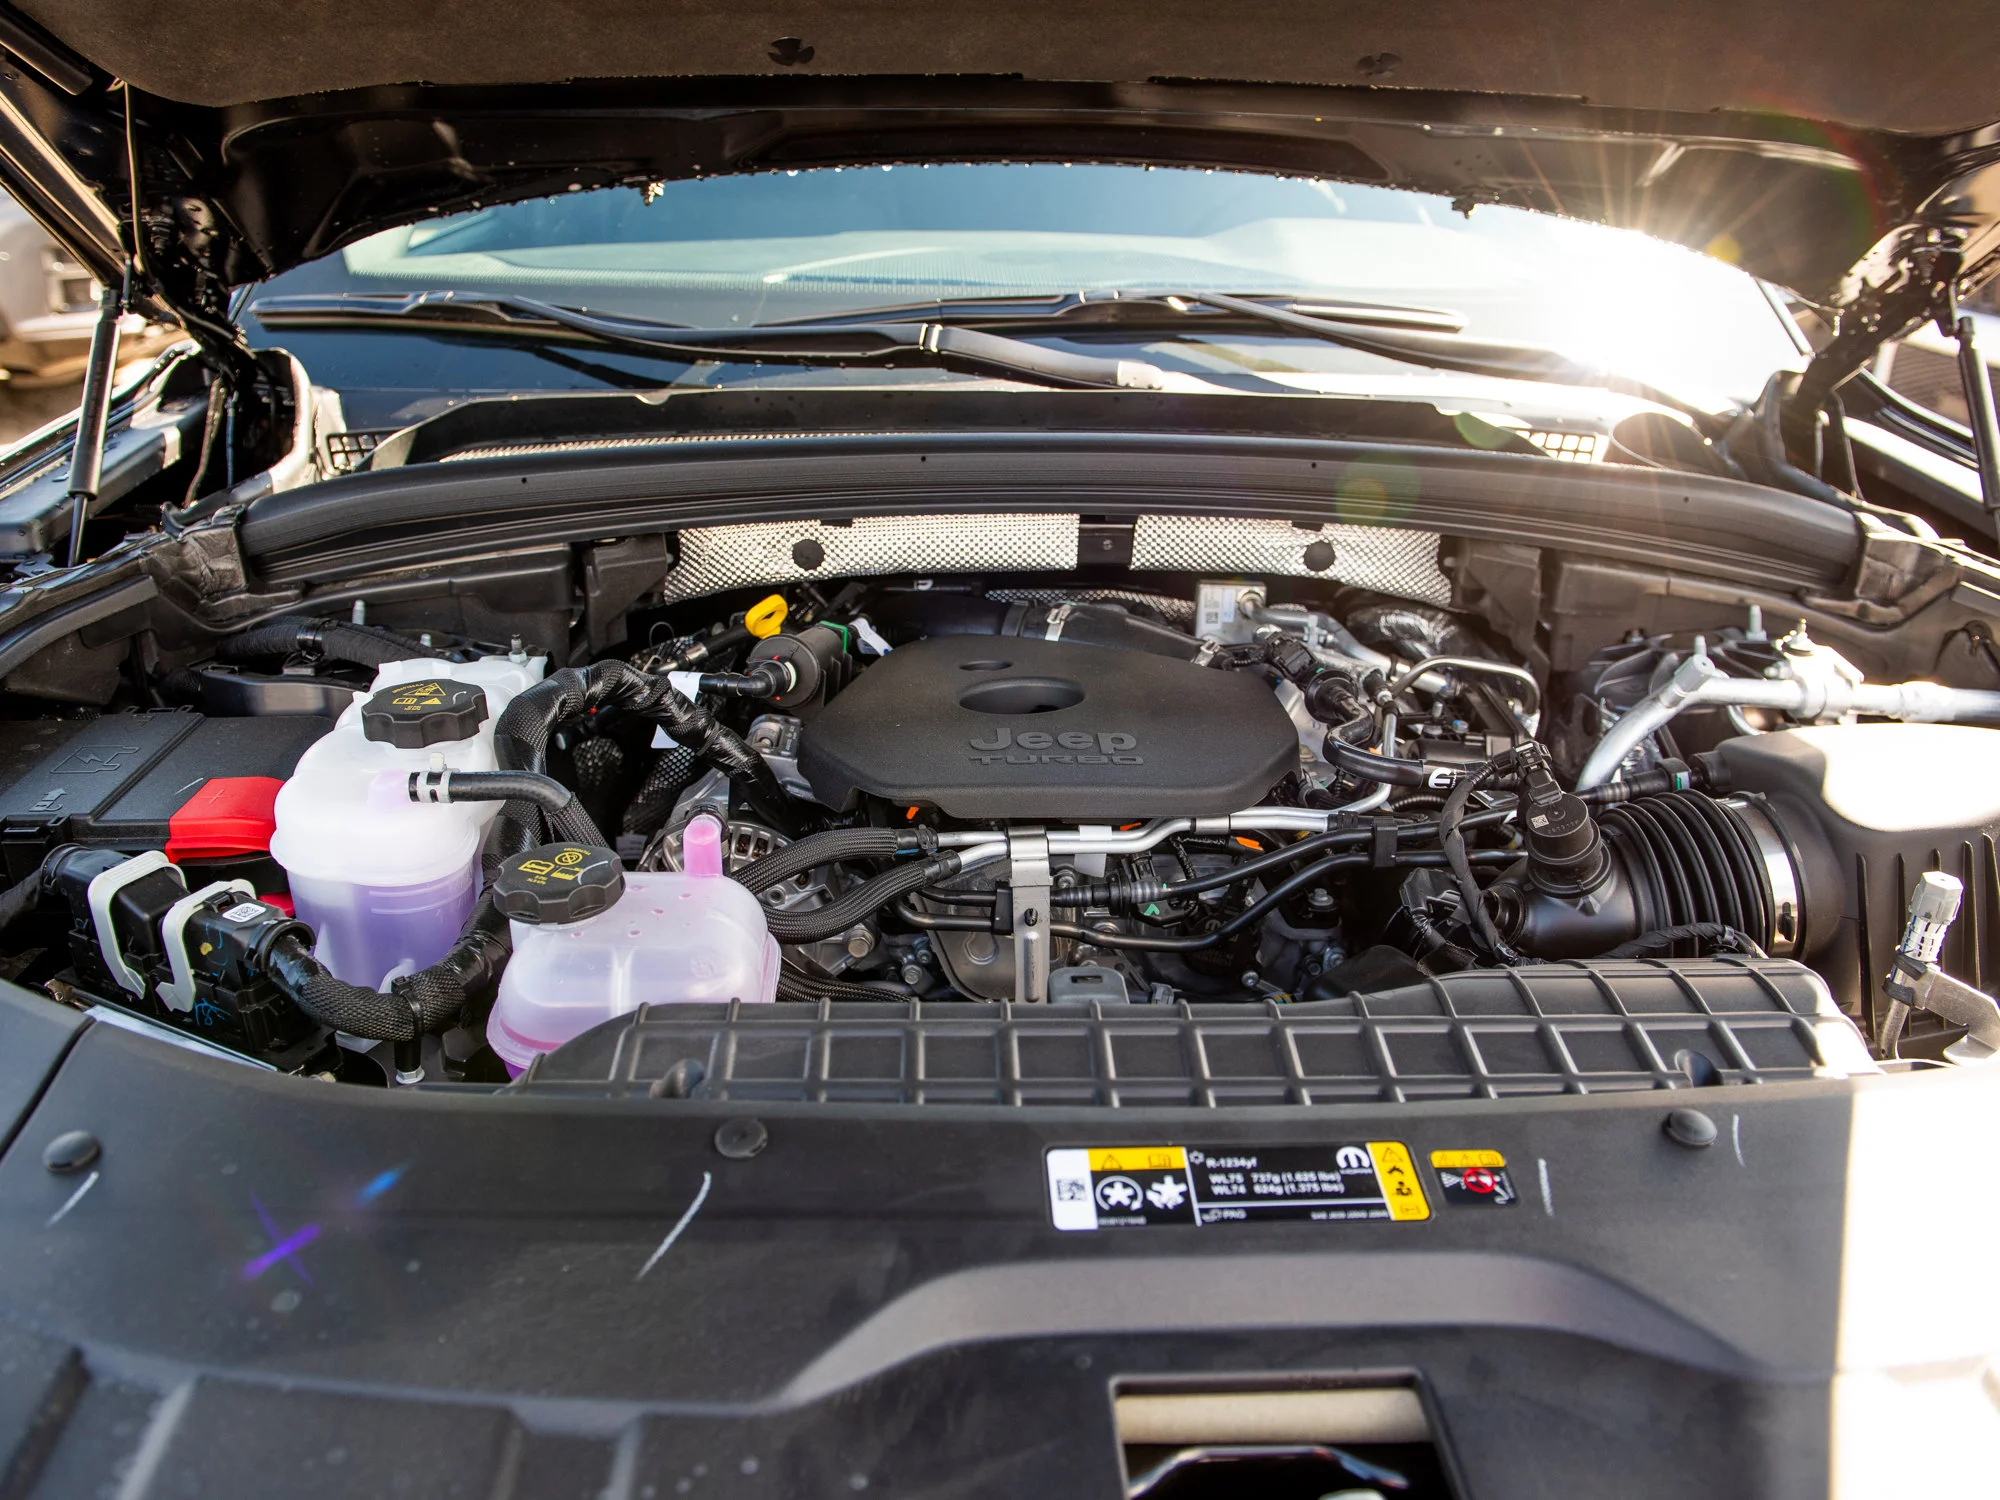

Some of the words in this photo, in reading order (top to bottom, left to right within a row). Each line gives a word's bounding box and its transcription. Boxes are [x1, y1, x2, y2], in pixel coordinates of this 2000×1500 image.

[969, 727, 1137, 755] Jeep
[968, 755, 1144, 765] TURBO
[1205, 1156, 1257, 1170] R-1234yf
